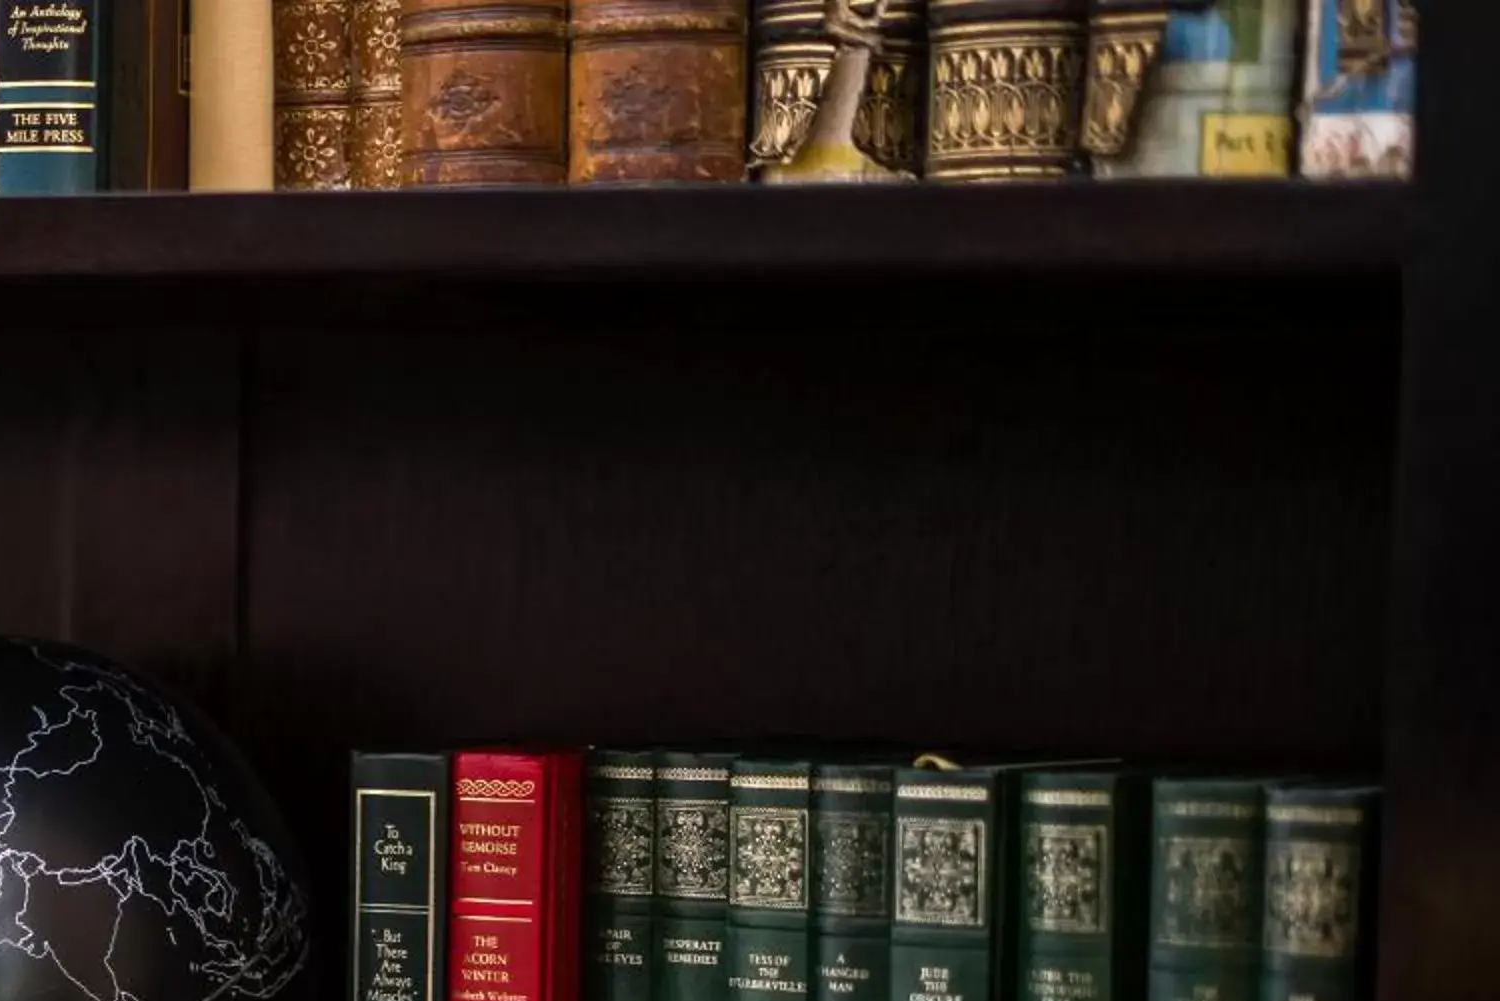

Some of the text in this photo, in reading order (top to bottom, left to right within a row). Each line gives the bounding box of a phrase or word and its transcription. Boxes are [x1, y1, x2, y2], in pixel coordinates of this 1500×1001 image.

[9, 3, 82, 21] An Anthology
[7, 19, 87, 37] of Inspirational
[21, 36, 70, 53] Thoughts
[12, 113, 78, 125] THE FIVE
[5, 129, 84, 143] MILE PRESS
[384, 824, 399, 839] To
[459, 824, 521, 837] WITHOUT
[373, 839, 414, 856] Catch a
[462, 841, 517, 855] REMORSE
[380, 857, 407, 875] King
[483, 862, 518, 877] Clancy
[473, 935, 498, 949] THE
[375, 943, 408, 959] There
[380, 959, 402, 973] Are
[464, 953, 508, 966] ACORN
[748, 953, 772, 966] TESS
[372, 973, 412, 988] Always
[461, 969, 510, 983] WINTER
[919, 967, 949, 981] JUDE
[828, 980, 854, 993] MAN
[924, 981, 948, 993] THE
